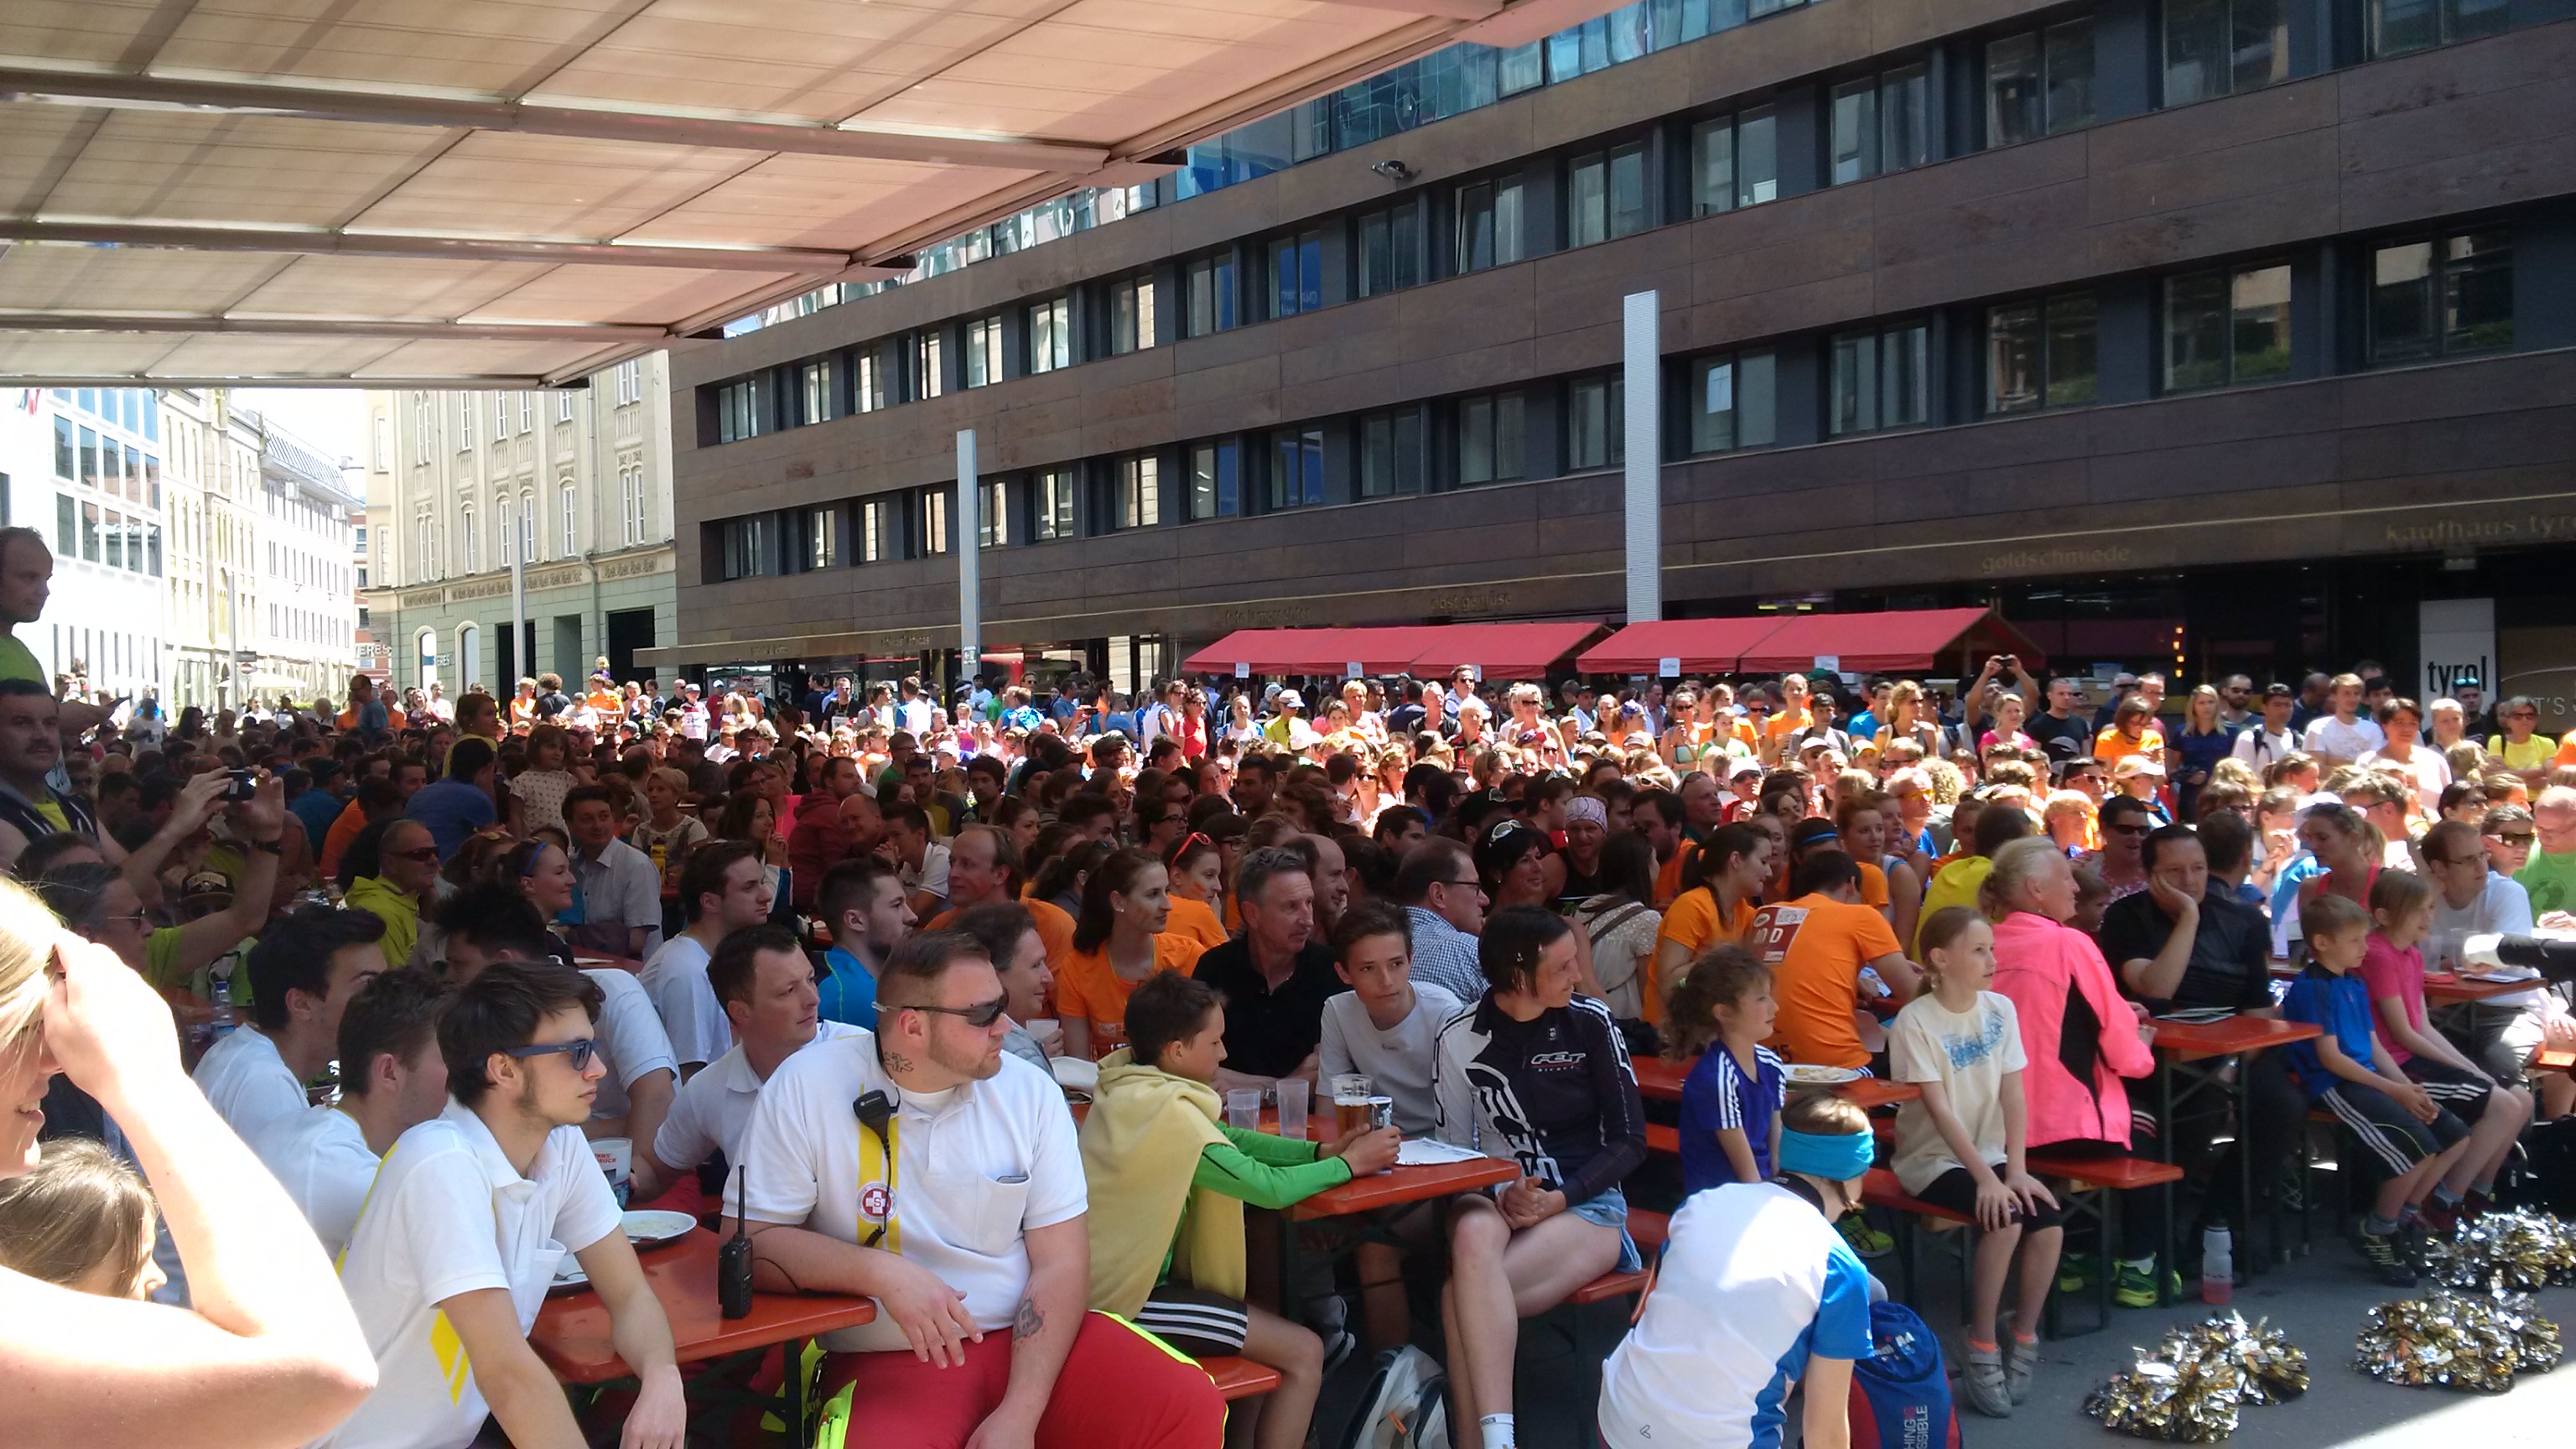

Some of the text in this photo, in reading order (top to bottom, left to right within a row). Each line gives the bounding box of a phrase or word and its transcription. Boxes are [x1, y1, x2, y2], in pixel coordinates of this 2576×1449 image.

[2386, 513, 2576, 541] kaufhaus tyr
[1981, 546, 2131, 574] goldschmiede
[2428, 656, 2487, 698] tyrol
[874, 1197, 881, 1208] S
[1903, 1419, 1916, 1449] HING
[1916, 1405, 1929, 1449] SSIBLE
